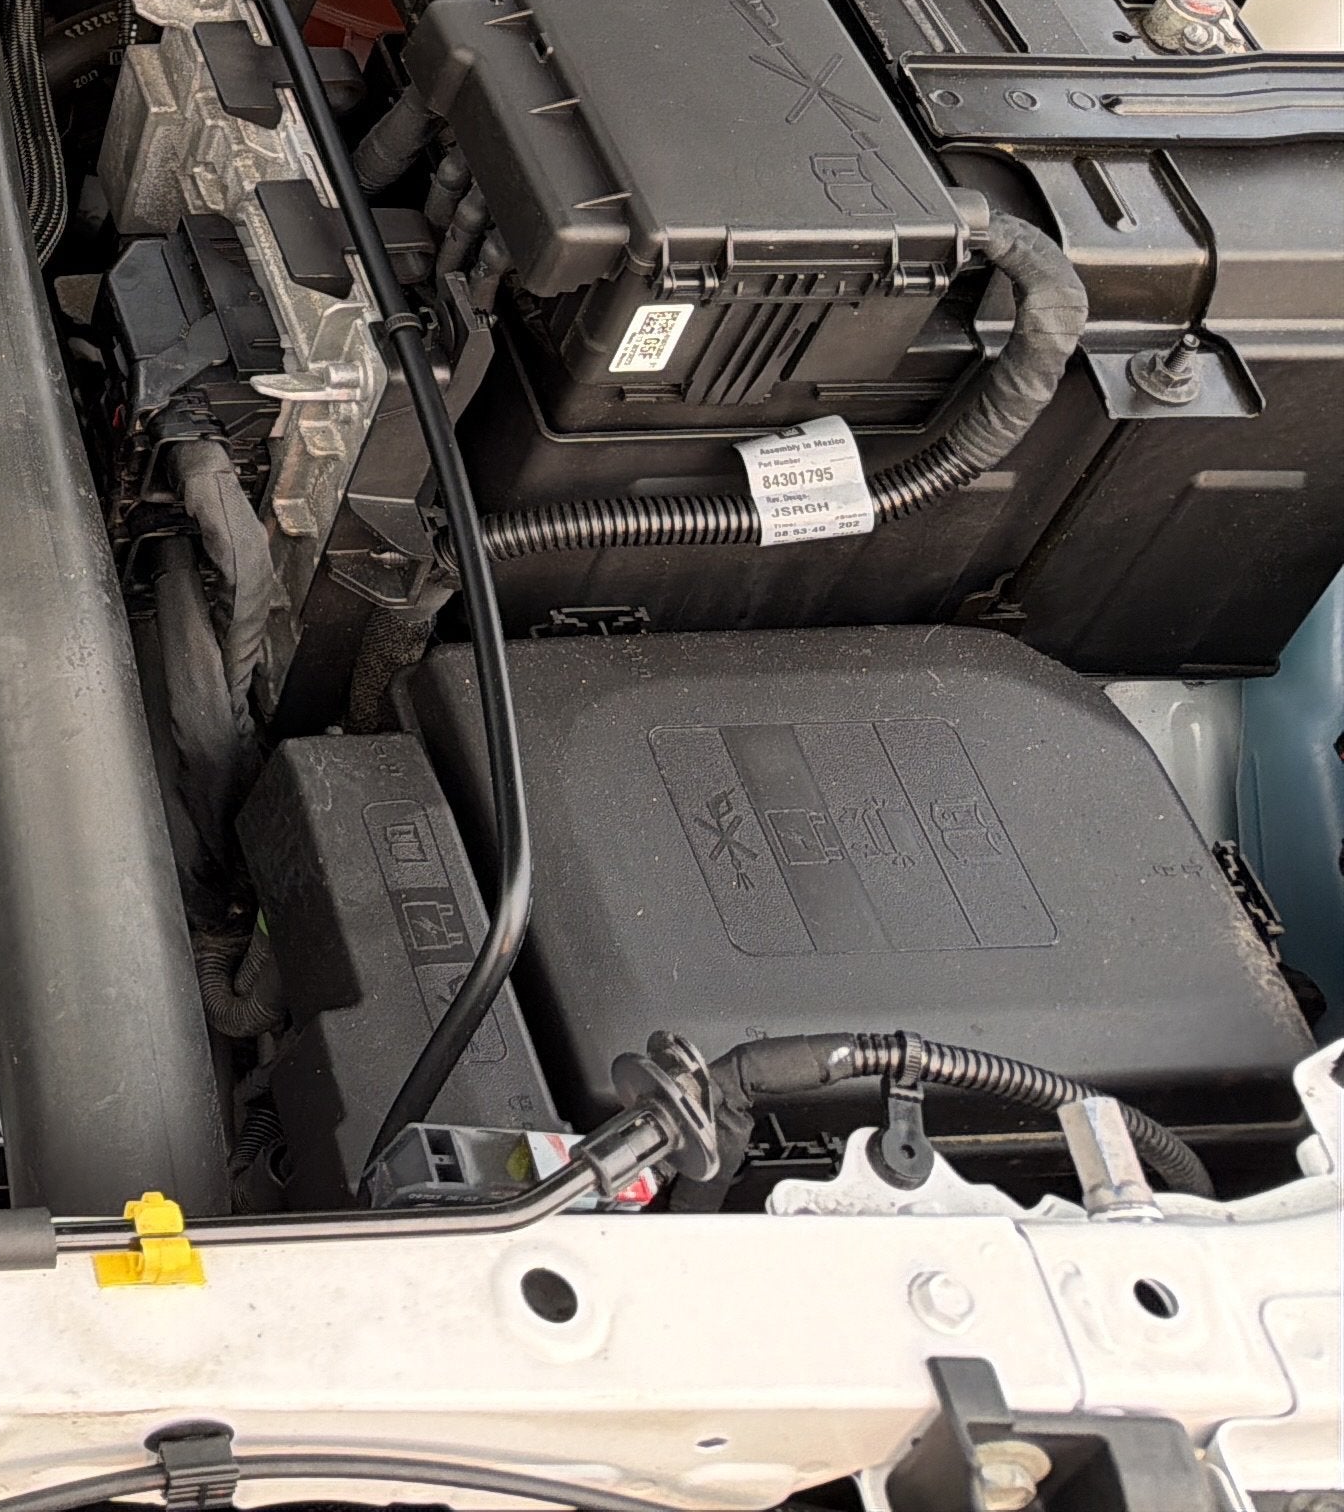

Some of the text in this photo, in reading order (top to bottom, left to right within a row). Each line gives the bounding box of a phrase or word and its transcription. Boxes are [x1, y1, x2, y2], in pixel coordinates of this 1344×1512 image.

[760, 444, 800, 455] Assembly
[814, 438, 846, 447] Mexico
[762, 467, 834, 489] 84301795
[772, 502, 830, 518] JSRGH
[838, 520, 860, 529] 202
